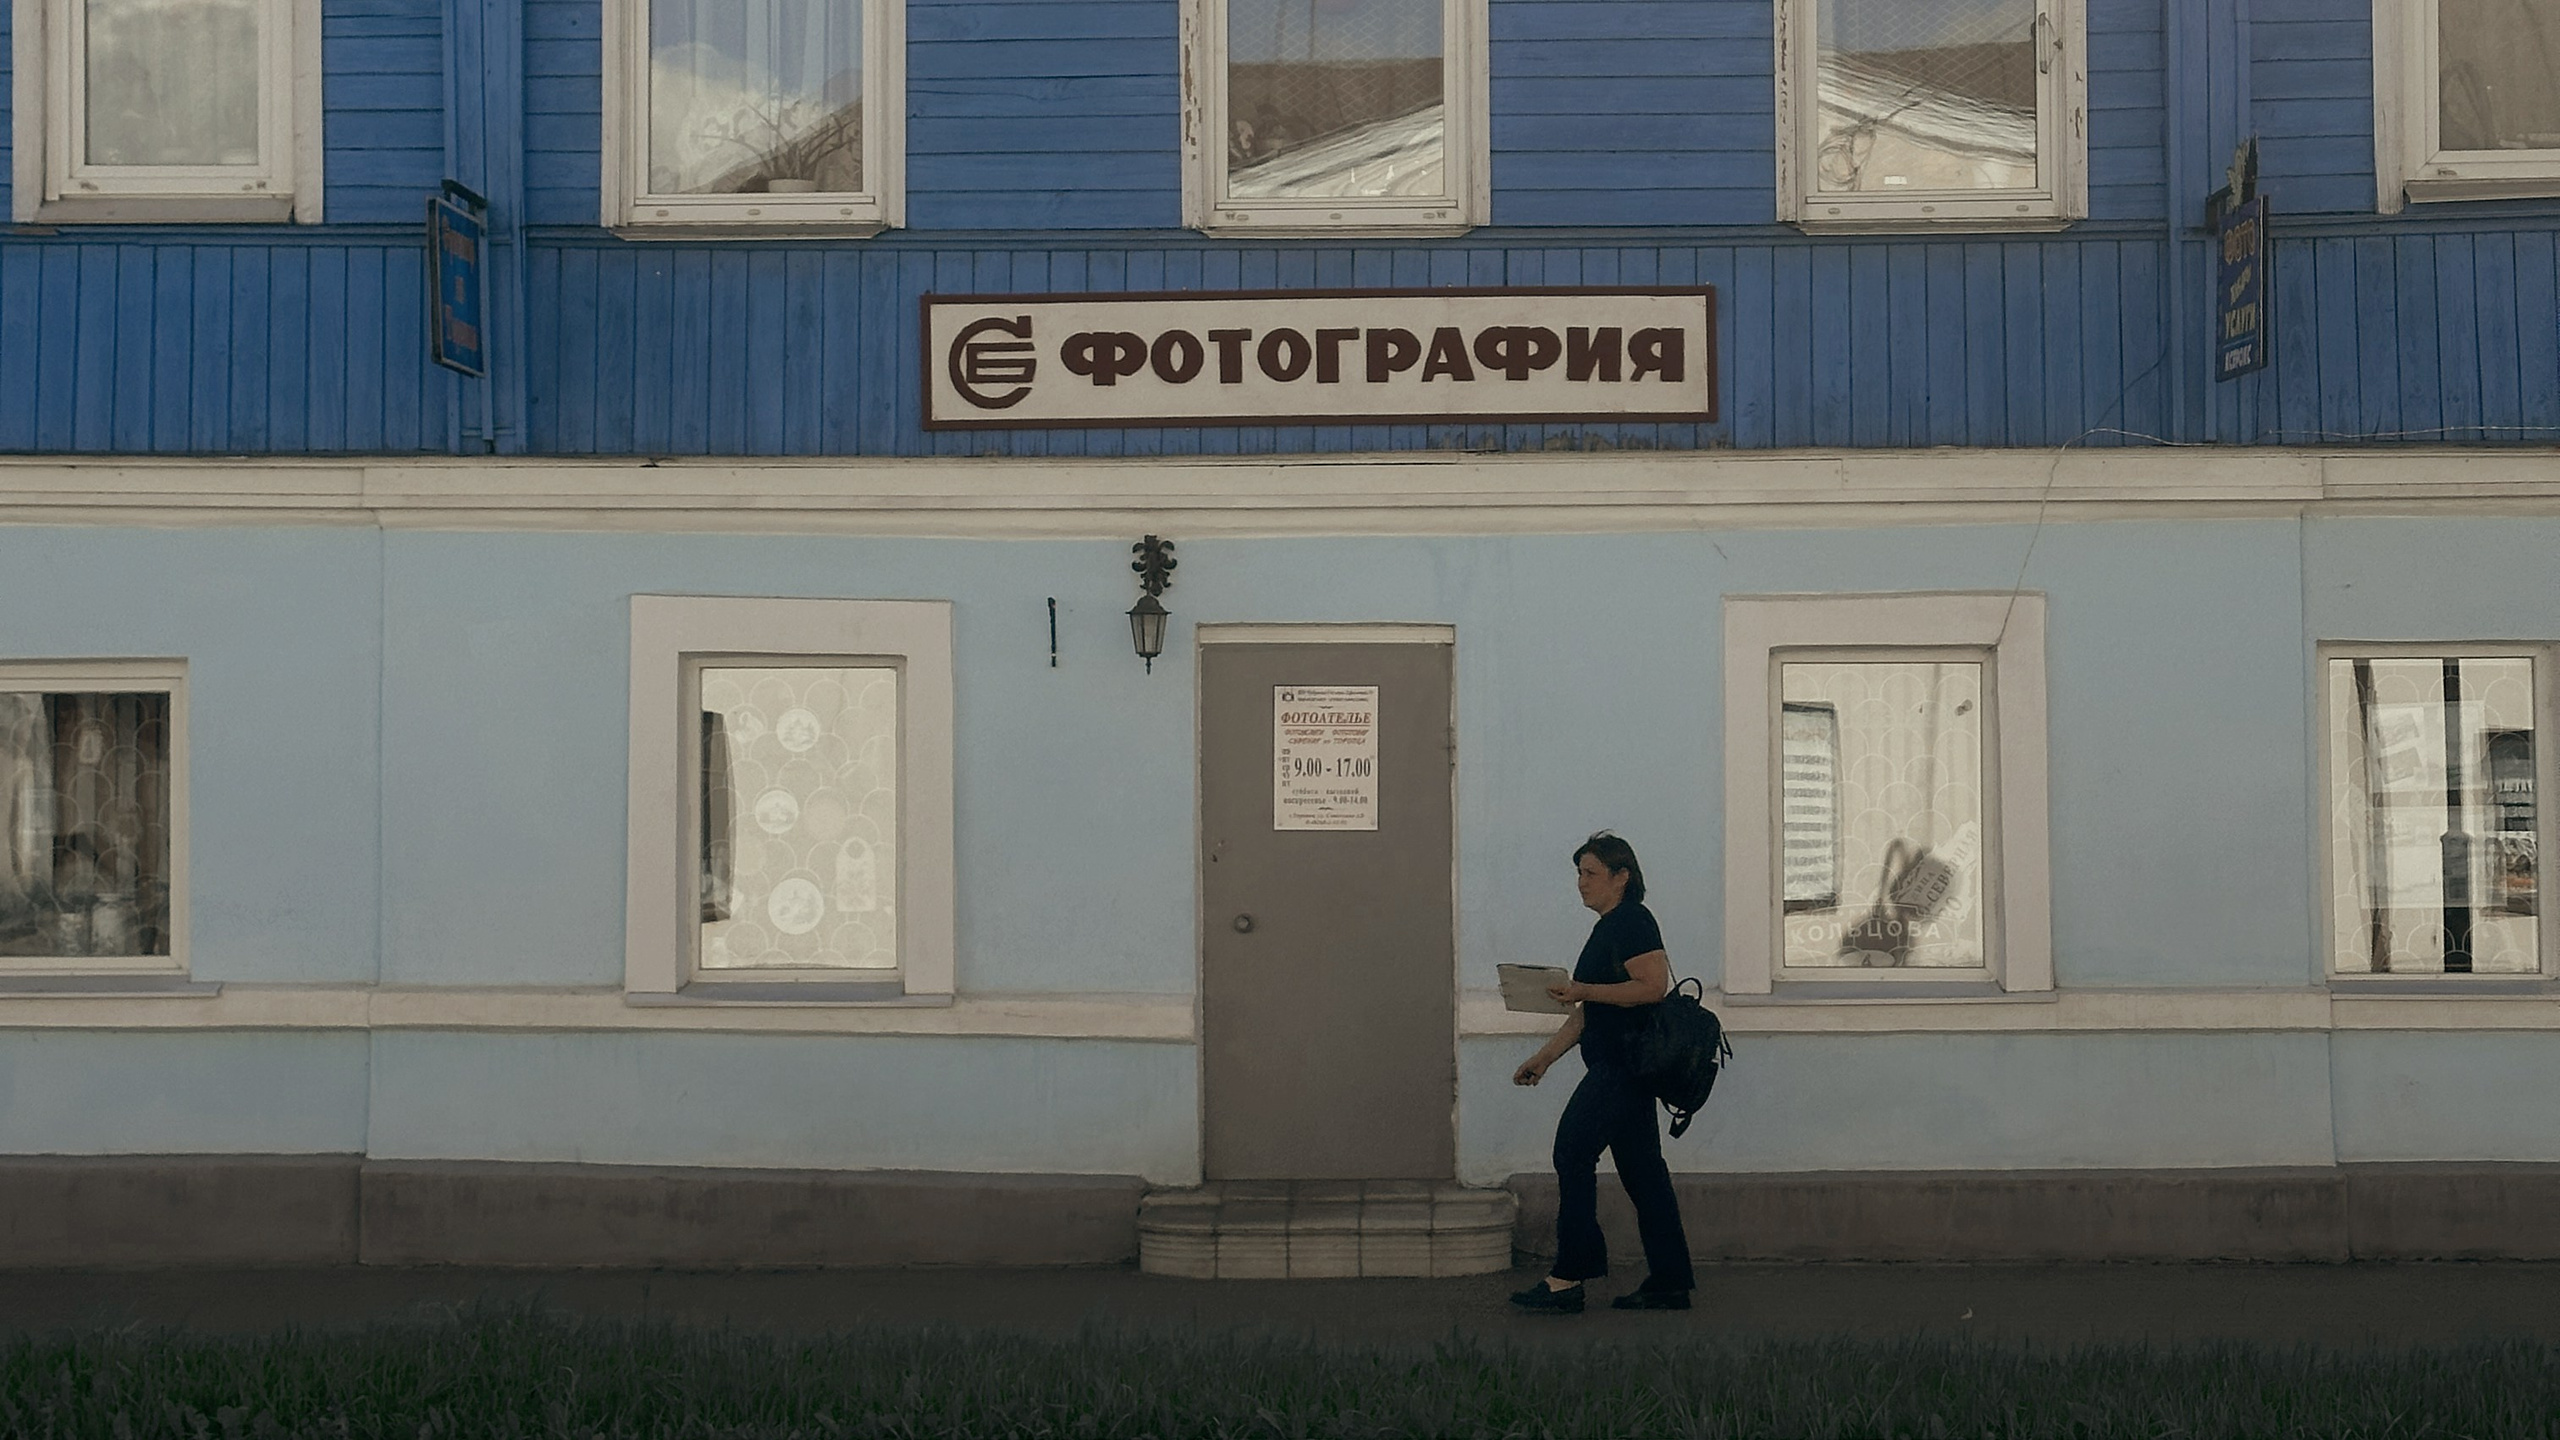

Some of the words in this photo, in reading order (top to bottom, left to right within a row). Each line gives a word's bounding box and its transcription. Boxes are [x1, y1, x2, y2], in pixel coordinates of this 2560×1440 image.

[1059, 325, 1686, 386] ФОТОГРАФИЯ
[1281, 712, 1371, 724] ФОТОАТЕЛЬЕ
[1294, 757, 1322, 777] 9.00
[1336, 757, 1371, 777] 17.00
[1791, 920, 1941, 944] КОЛЬЦОВА
